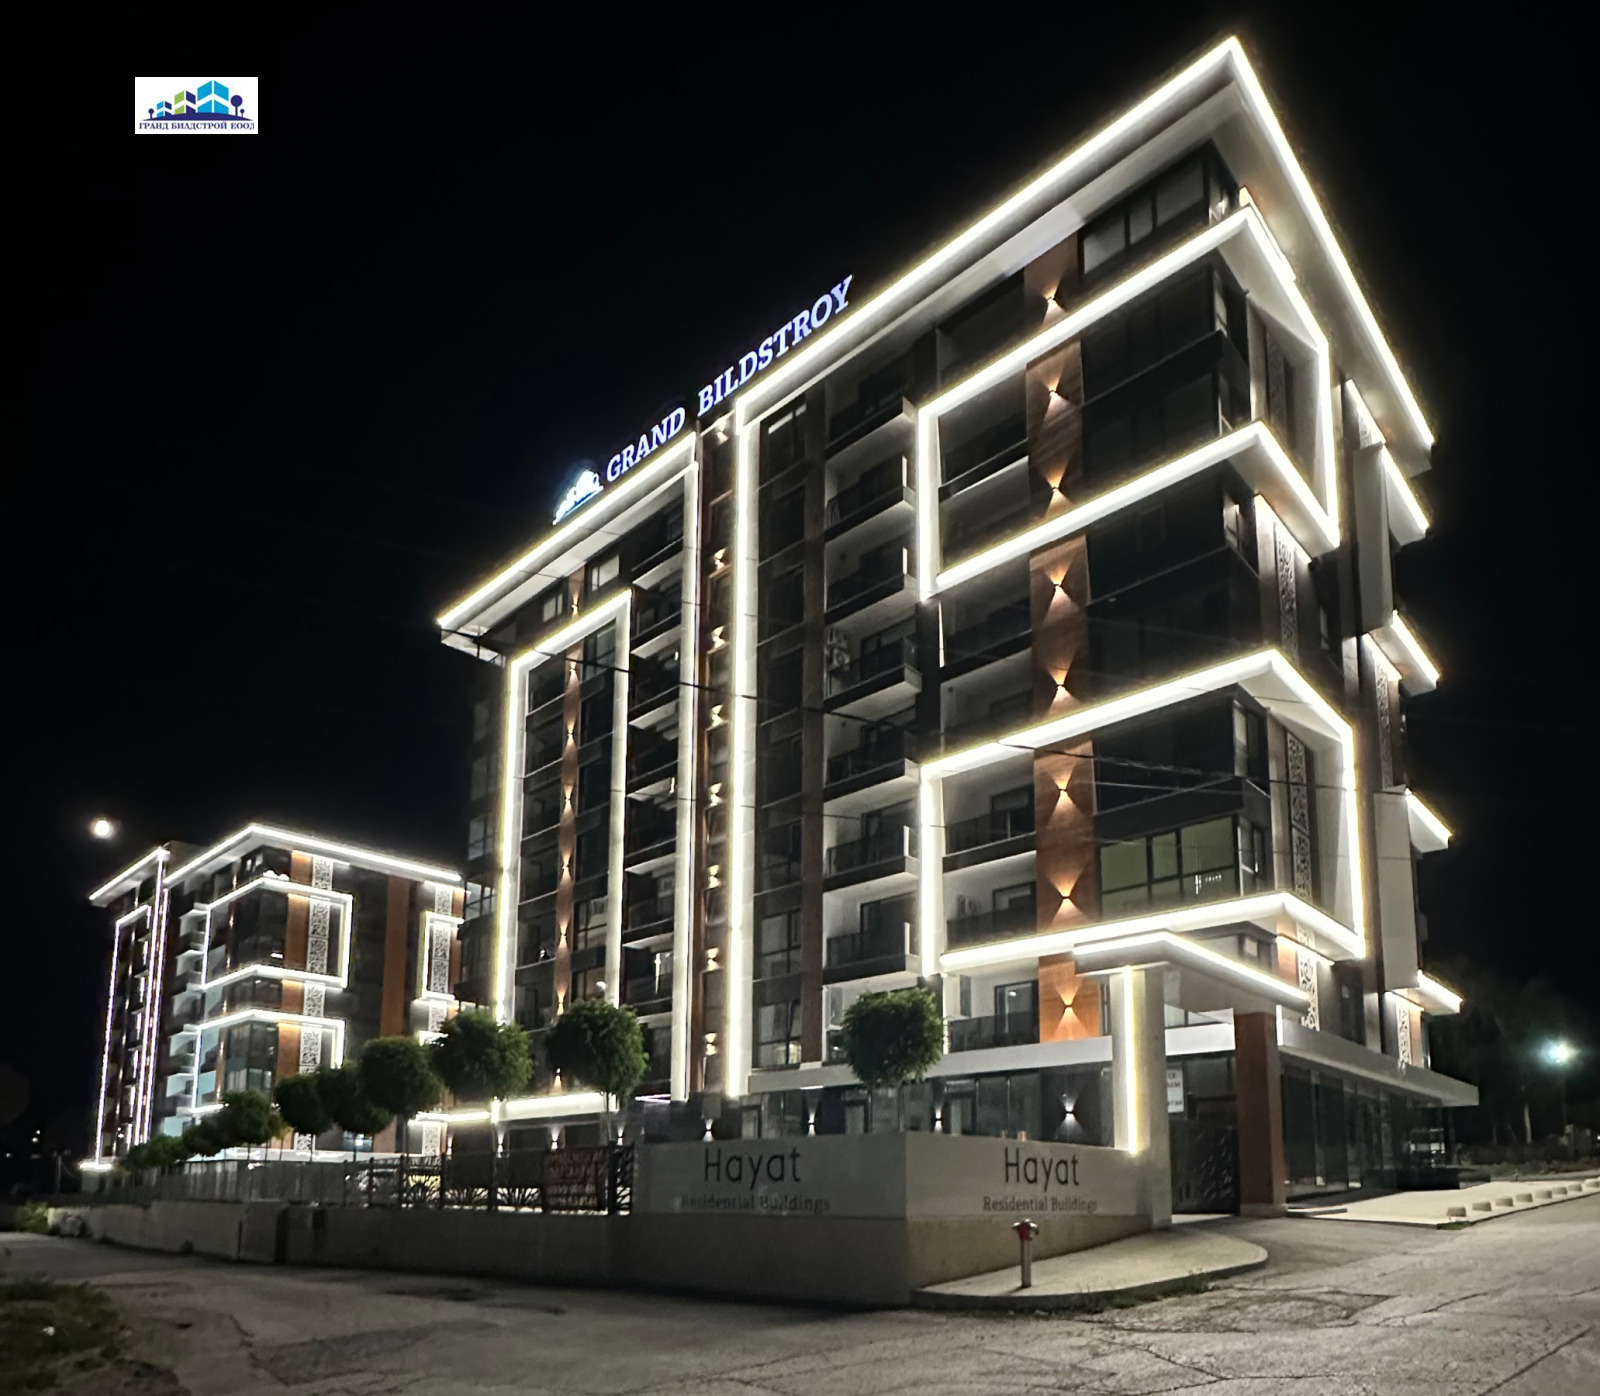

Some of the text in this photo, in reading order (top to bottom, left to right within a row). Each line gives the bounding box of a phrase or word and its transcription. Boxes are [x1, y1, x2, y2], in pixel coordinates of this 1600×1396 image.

[606, 274, 853, 482] GRAND BILDSTROY
[704, 1147, 801, 1190] Hayat
[1005, 1147, 1079, 1192] Hayat
[681, 1193, 831, 1213] Residential Buildings
[983, 1196, 1098, 1213] Residential Buildings
